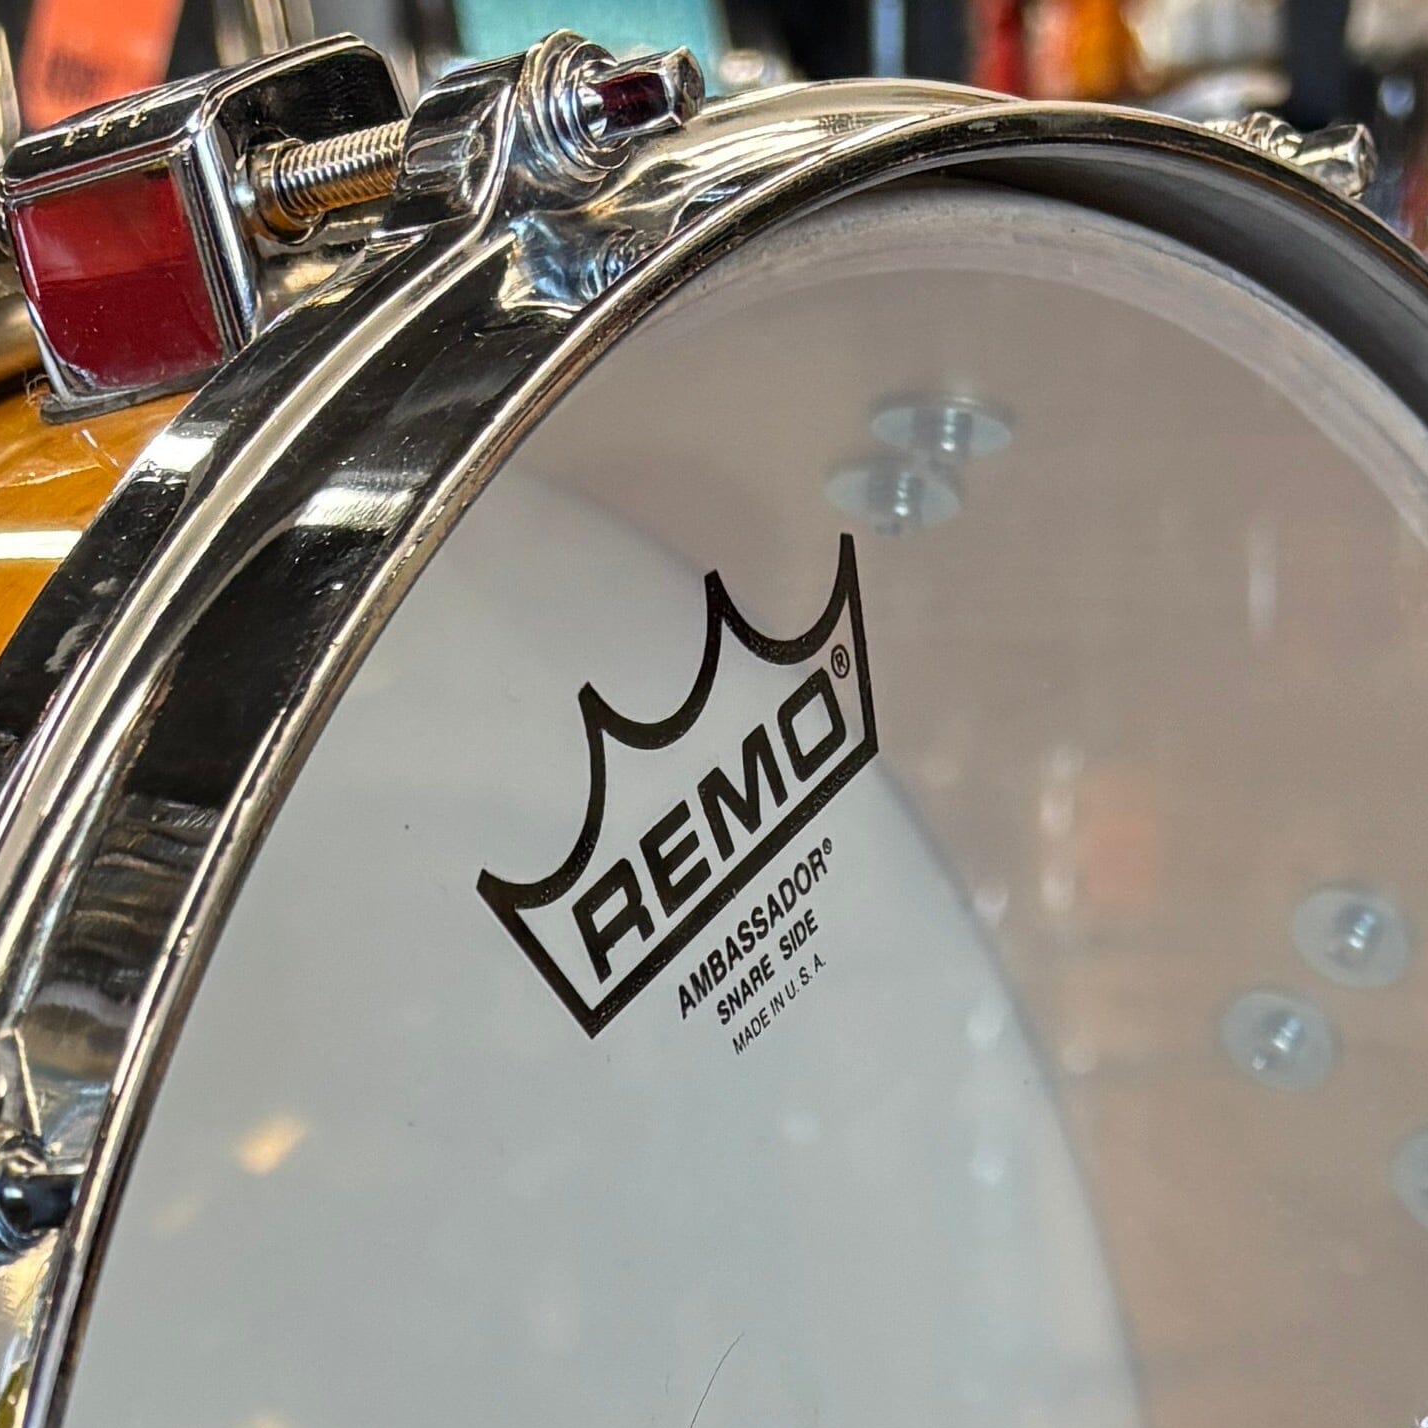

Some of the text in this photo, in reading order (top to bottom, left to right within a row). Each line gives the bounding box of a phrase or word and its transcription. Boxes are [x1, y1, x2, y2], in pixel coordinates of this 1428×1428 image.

[572, 666, 848, 984] REMO
[716, 908, 819, 1026] SNARE SIDE
[731, 1006, 772, 1056] MADE
[770, 991, 786, 1018] IN
